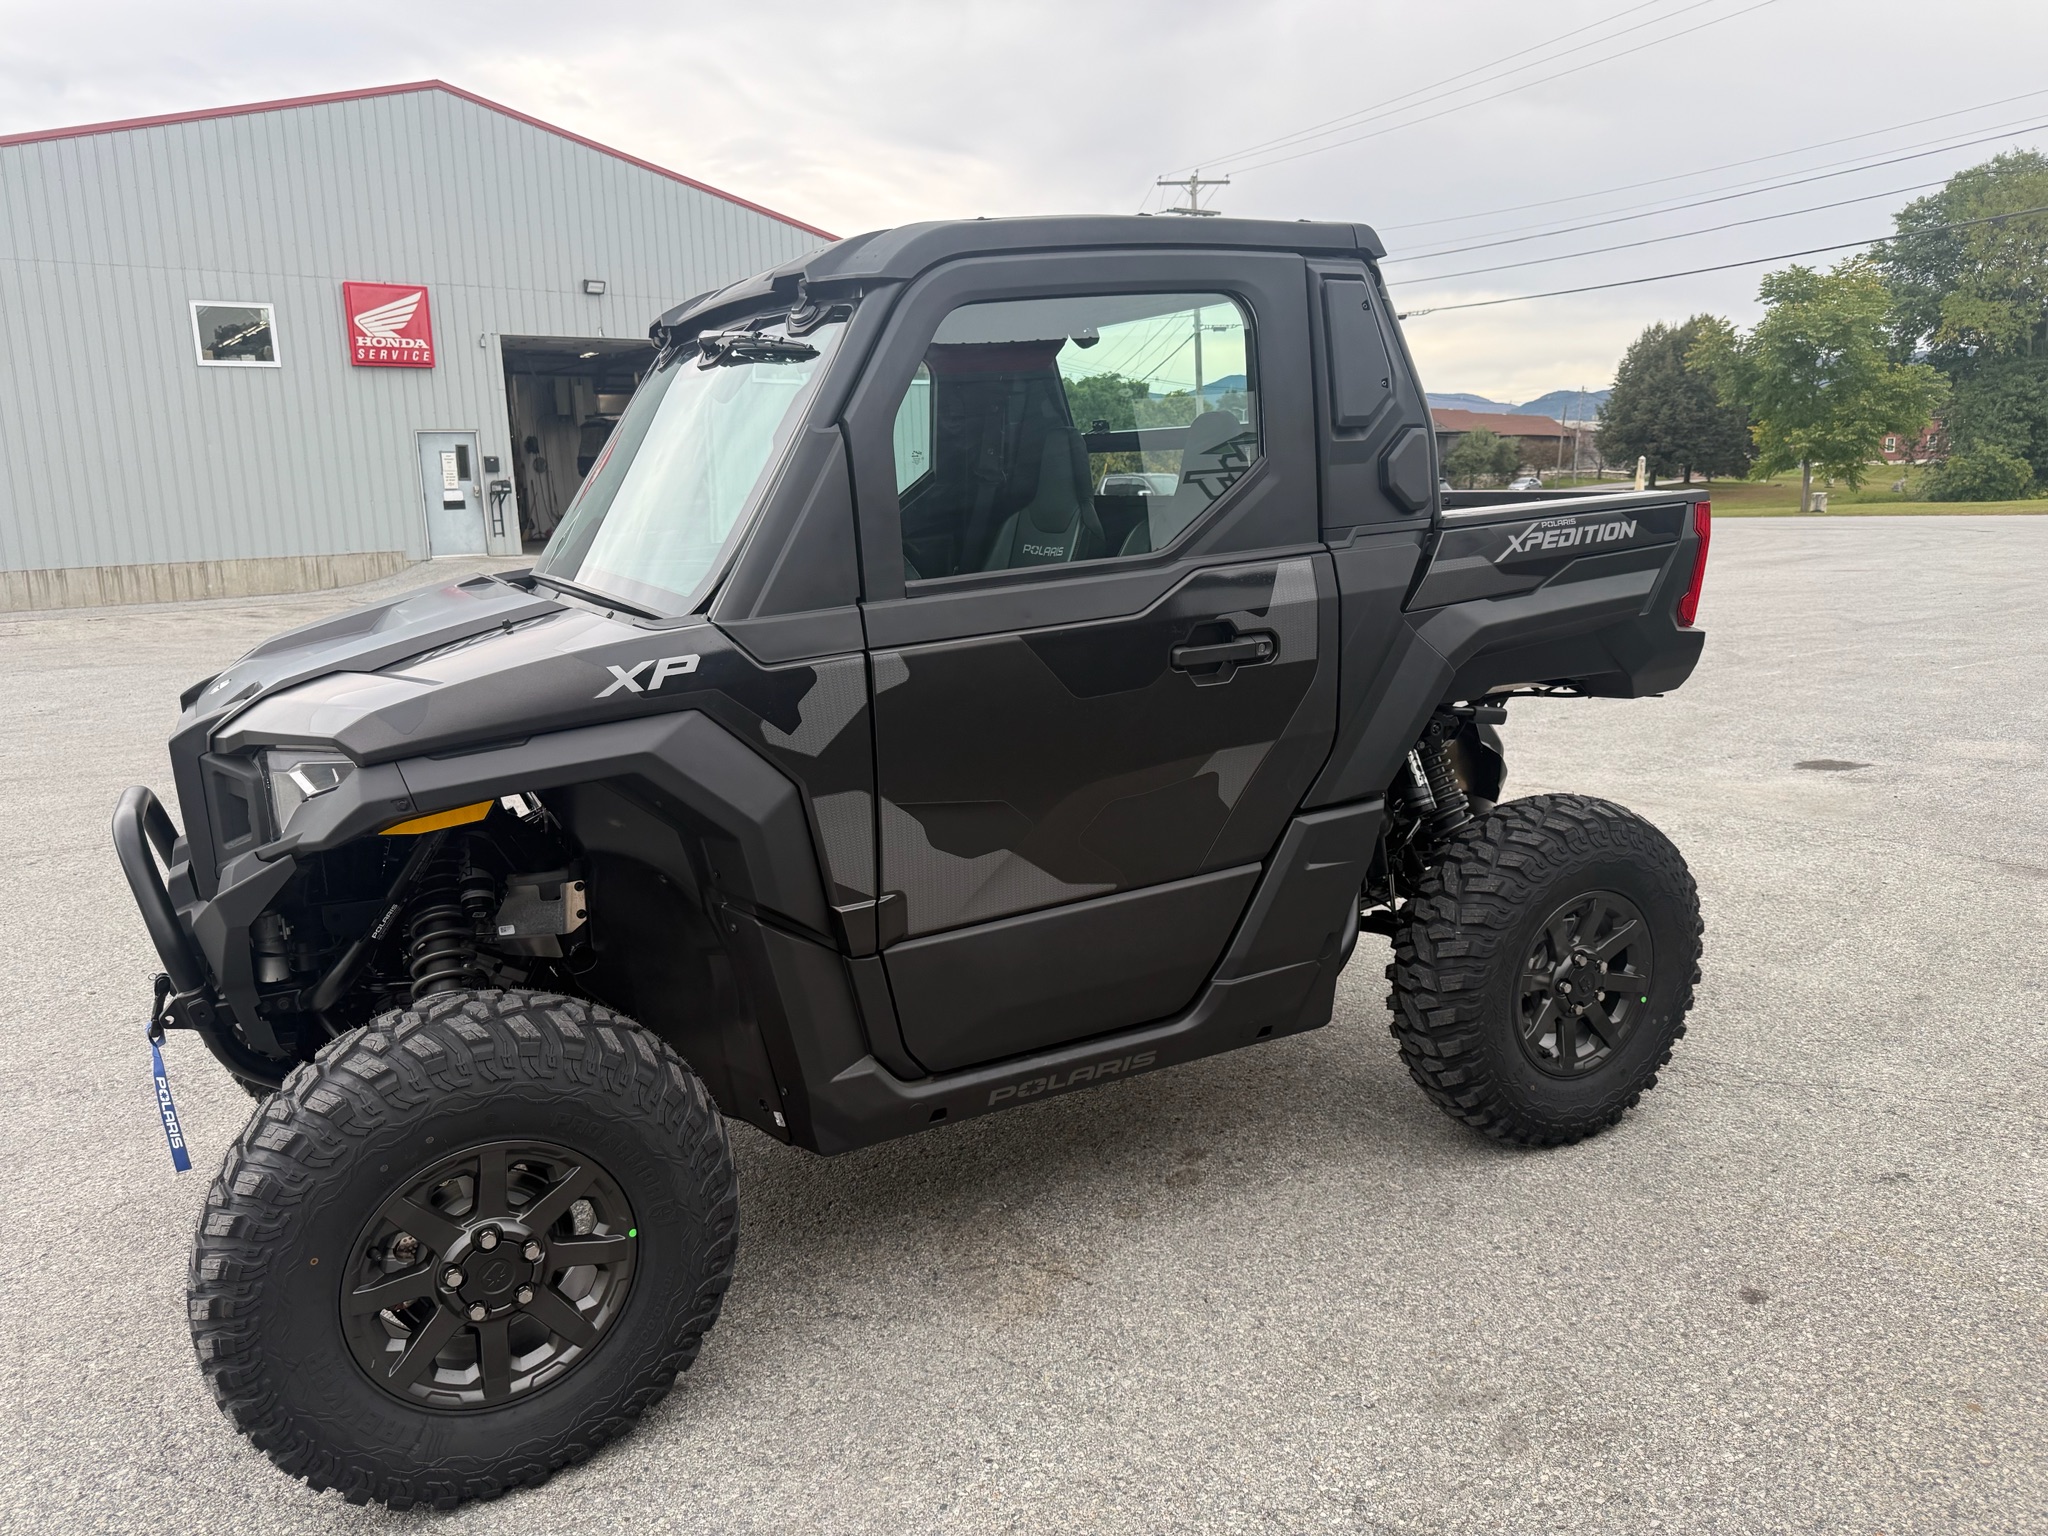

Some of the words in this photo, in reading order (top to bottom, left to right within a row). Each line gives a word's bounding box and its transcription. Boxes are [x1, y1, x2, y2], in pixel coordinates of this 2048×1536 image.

[355, 336, 430, 349] HONDA
[357, 348, 430, 361] SERVICE
[1541, 518, 1577, 528] POLARIS
[1022, 544, 1064, 557] POLARIS
[1494, 520, 1637, 563] XPEDITION
[593, 653, 701, 699] XP
[371, 903, 398, 939] POLARIS
[987, 1050, 1157, 1106] POLARIS
[155, 1076, 184, 1149] POLARIS
